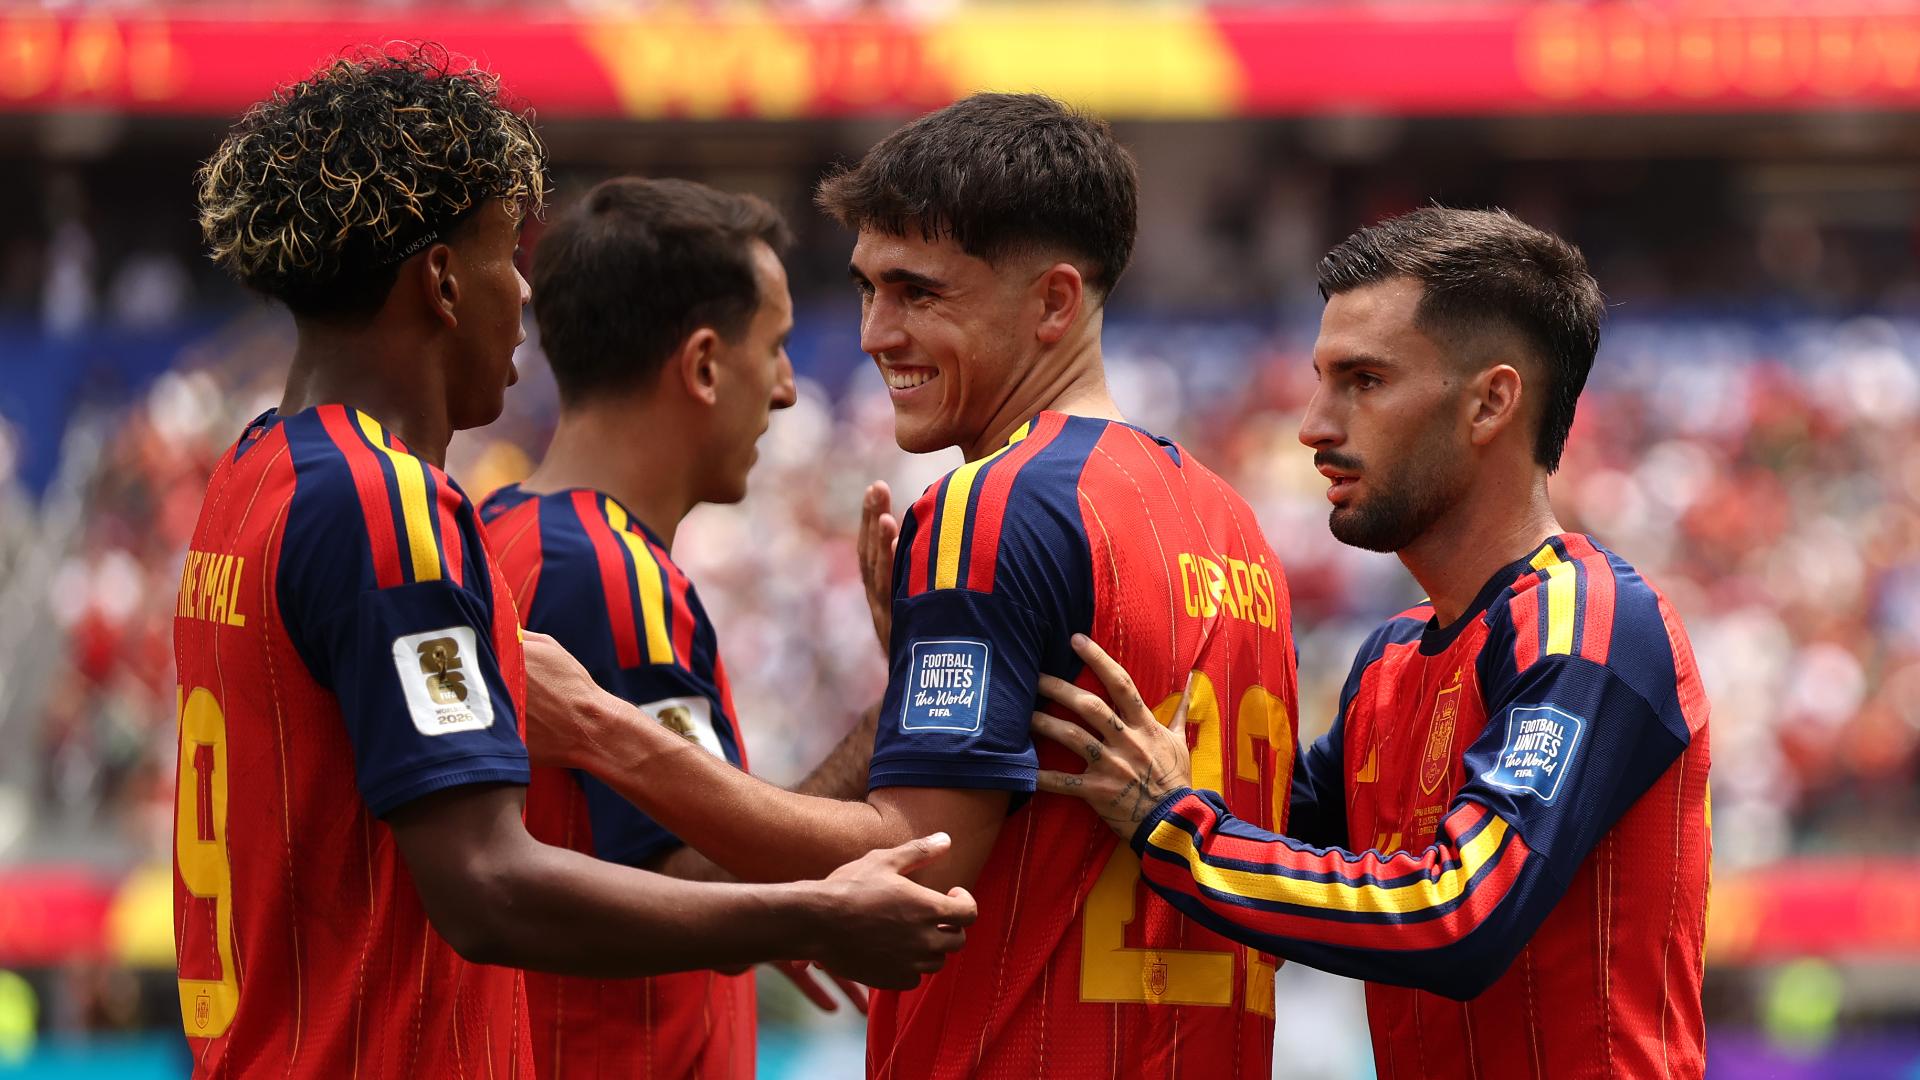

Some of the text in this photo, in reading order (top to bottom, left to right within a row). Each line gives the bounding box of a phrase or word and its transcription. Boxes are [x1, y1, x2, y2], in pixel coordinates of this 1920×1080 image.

[922, 653, 974, 669] FOOTBALL
[920, 669, 974, 689] UNITES
[915, 689, 975, 708] the World
[437, 713, 473, 725] 2026
[929, 709, 952, 717] FIFA
[1520, 719, 1564, 740] FOOTBALL
[1513, 733, 1561, 758] UNITES
[1505, 752, 1557, 776] the World
[1514, 769, 1534, 778] FIFA
[175, 684, 241, 1040] 9
